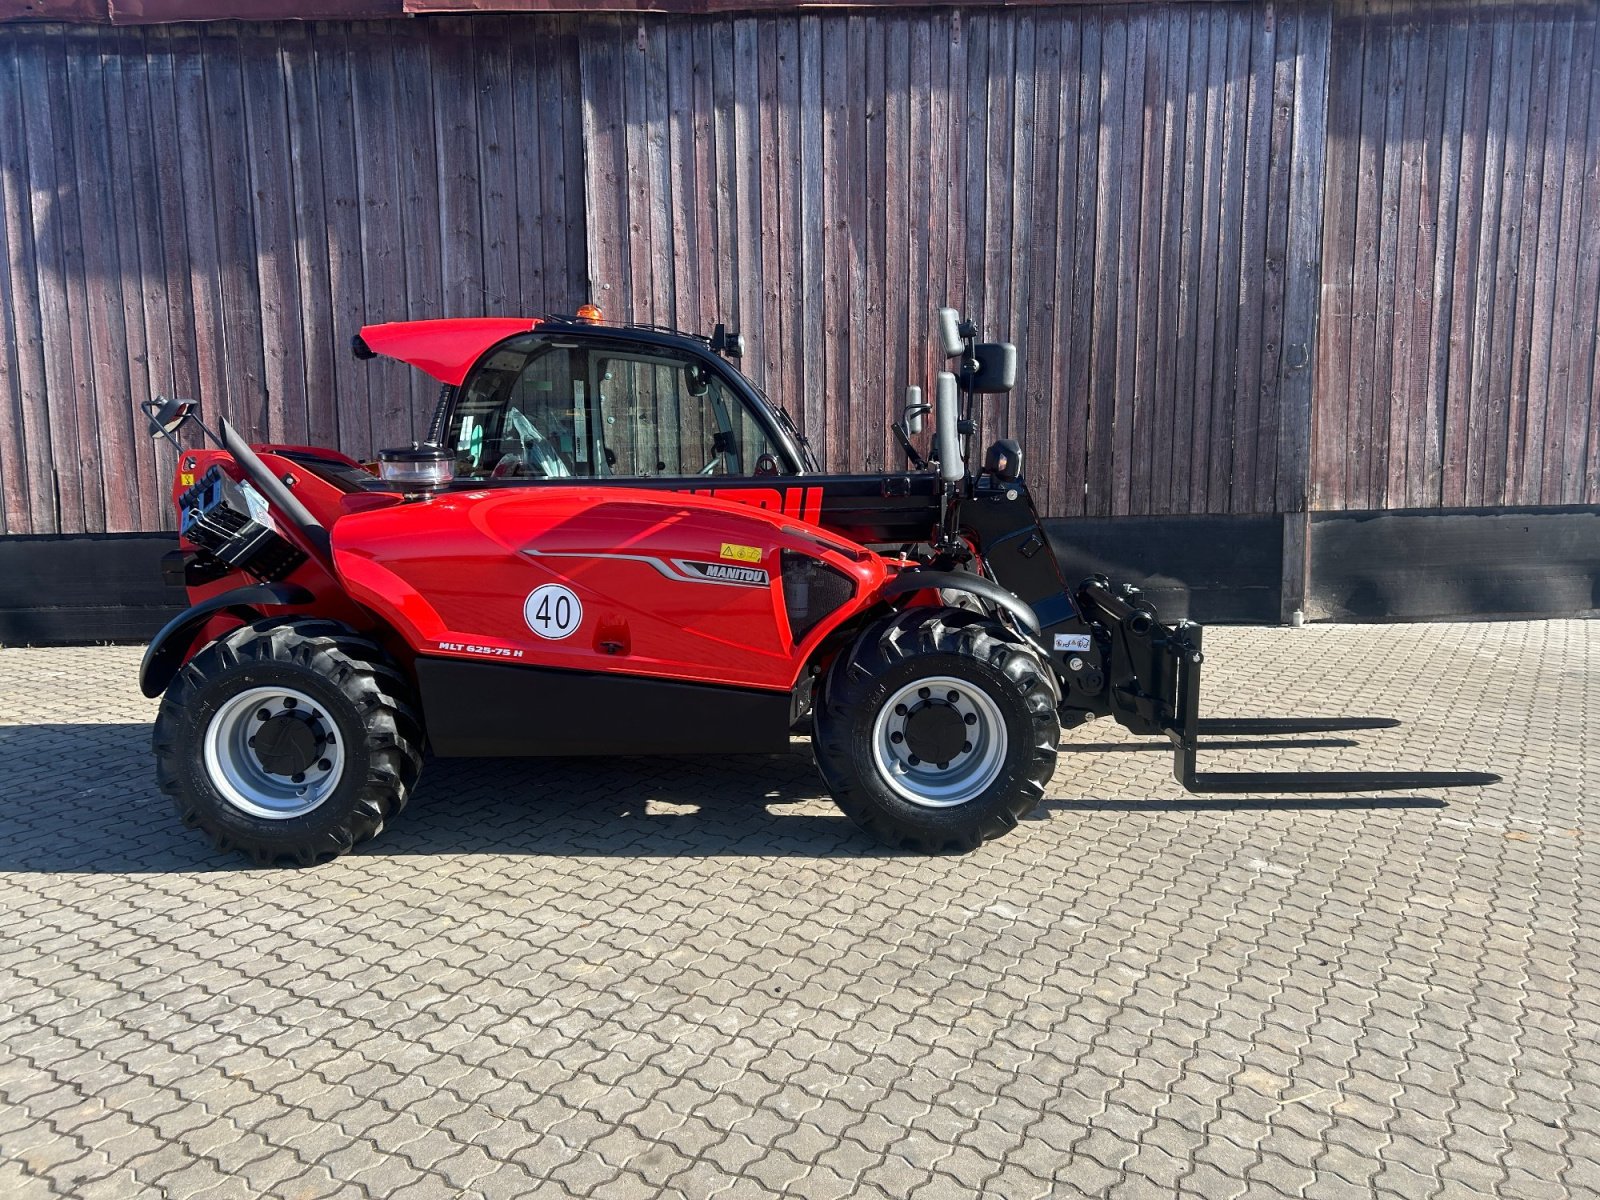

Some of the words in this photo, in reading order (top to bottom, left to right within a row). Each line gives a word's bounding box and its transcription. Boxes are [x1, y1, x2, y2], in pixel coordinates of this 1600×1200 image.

[706, 565, 763, 582] MANITOU
[536, 594, 571, 629] 40
[439, 642, 465, 650] MLT
[466, 645, 511, 655] 625-75
